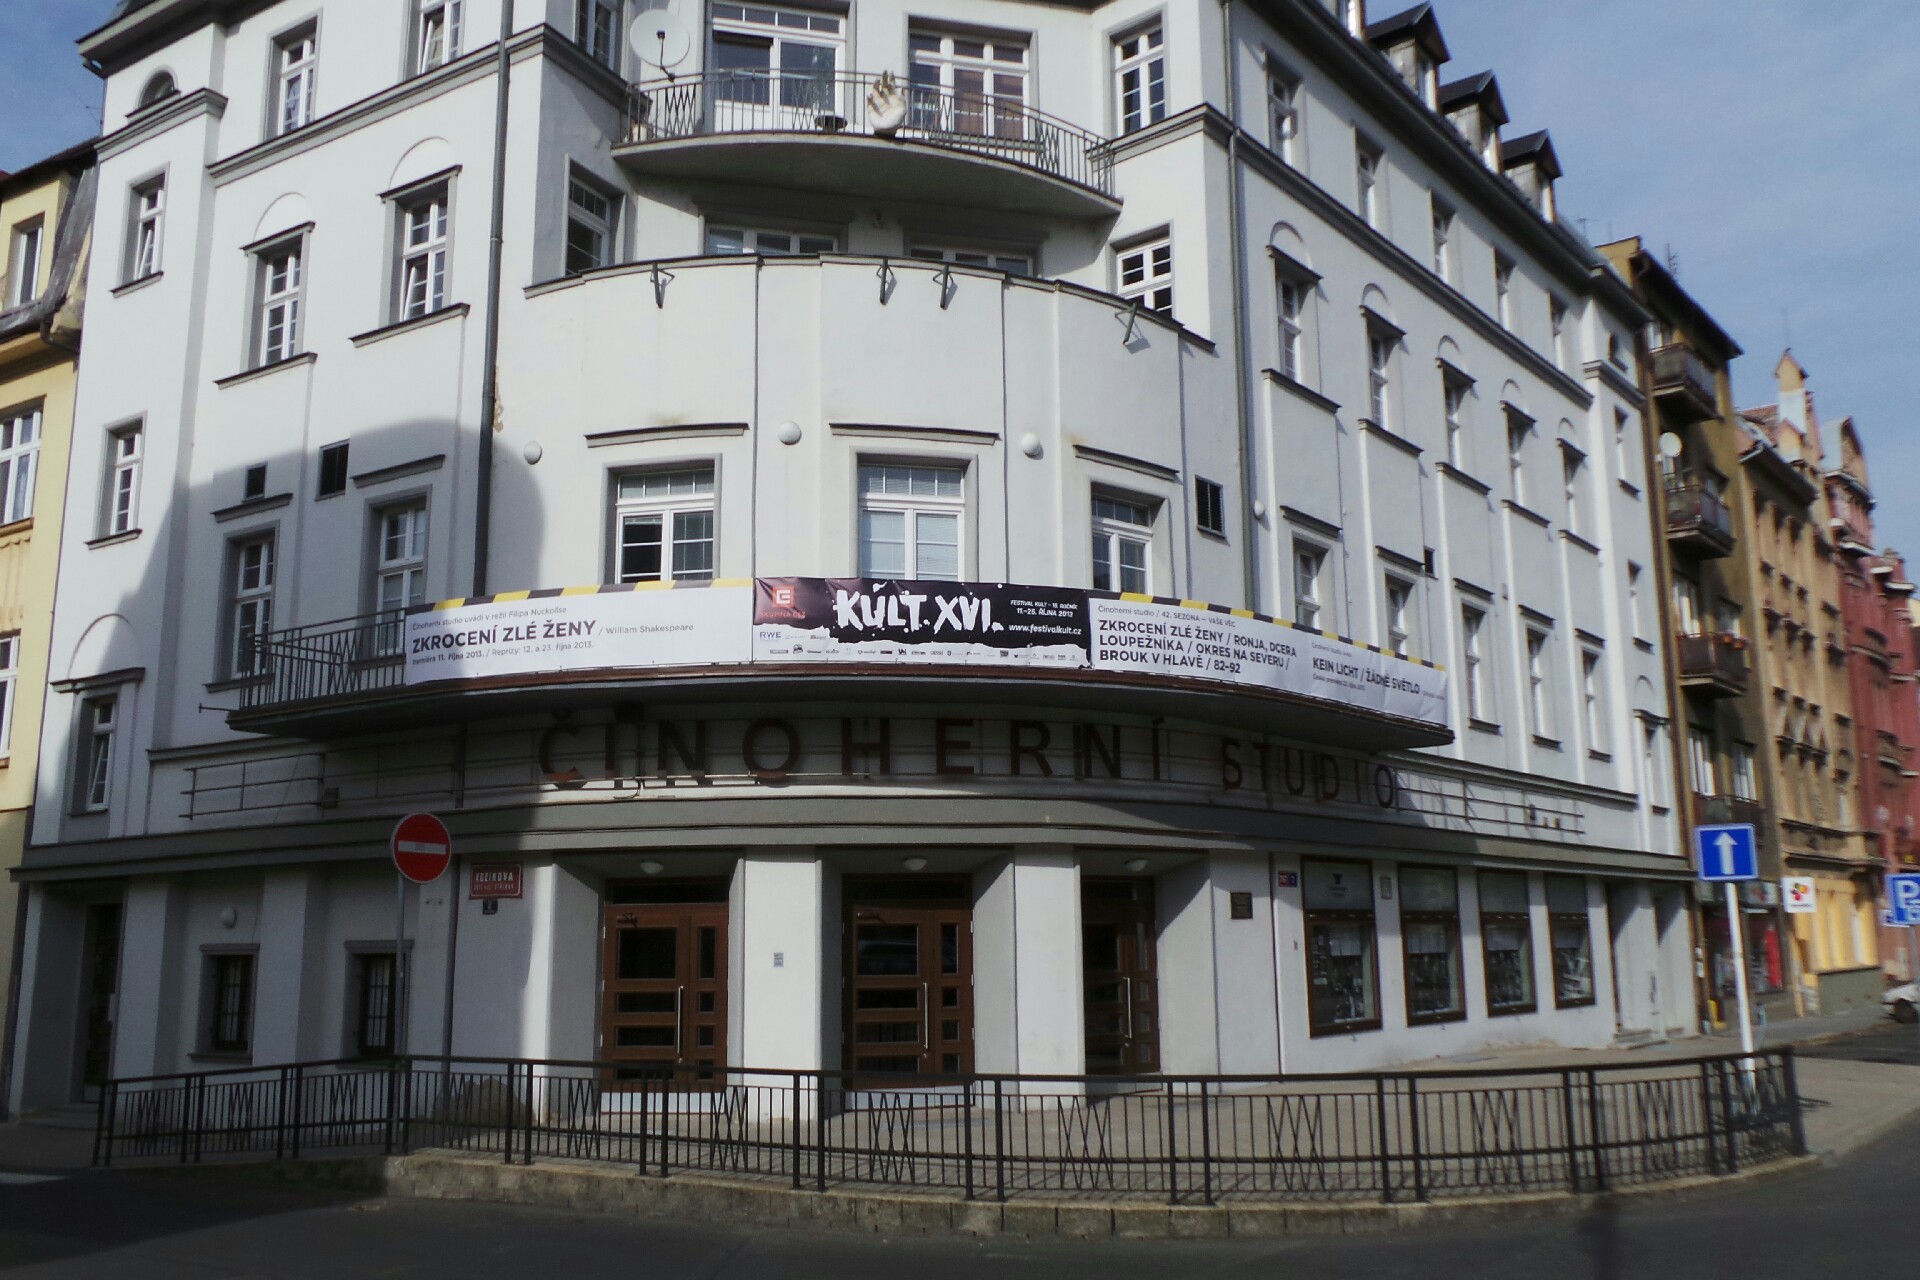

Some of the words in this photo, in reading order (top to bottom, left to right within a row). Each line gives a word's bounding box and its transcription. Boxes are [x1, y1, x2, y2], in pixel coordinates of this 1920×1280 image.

[442, 616, 463, 626] studio
[508, 610, 529, 619] Filipa
[1009, 624, 1082, 635] www.festivalkult.cz
[1098, 605, 1132, 613] Činoherní
[1208, 617, 1223, 626] VAŠE
[412, 624, 499, 654] ZKROCENÍ
[502, 621, 537, 642] ZLÉ
[543, 619, 597, 639] ŽENY
[605, 626, 637, 635] William
[639, 624, 694, 633] Shakespeare
[760, 631, 782, 639] RWE
[1099, 619, 1167, 635] ZKROCENÍ
[1170, 624, 1192, 638] ZLÉ
[1194, 626, 1224, 642] ŽENY
[1234, 635, 1268, 653] RONJA,
[1269, 642, 1297, 657] DCERA
[1100, 634, 1184, 651] LOUPEŽNÍKA
[1196, 643, 1231, 658] OKRES
[1233, 648, 1248, 661] NA
[1249, 651, 1284, 668] SEVERU
[1100, 649, 1148, 664] BROUK
[1152, 653, 1160, 664] V
[1163, 654, 1203, 668] HLAVĚ
[1213, 659, 1241, 674] 82-92
[1312, 657, 1334, 672] KEIN
[1336, 662, 1359, 679] LICHT
[1366, 667, 1390, 688] ŽÁDNÉ
[1392, 677, 1420, 694] SVĚTLO
[539, 708, 1164, 781] ČINOHERNÍ
[1221, 737, 1394, 809] STUDIO
[1897, 880, 1920, 909] P
